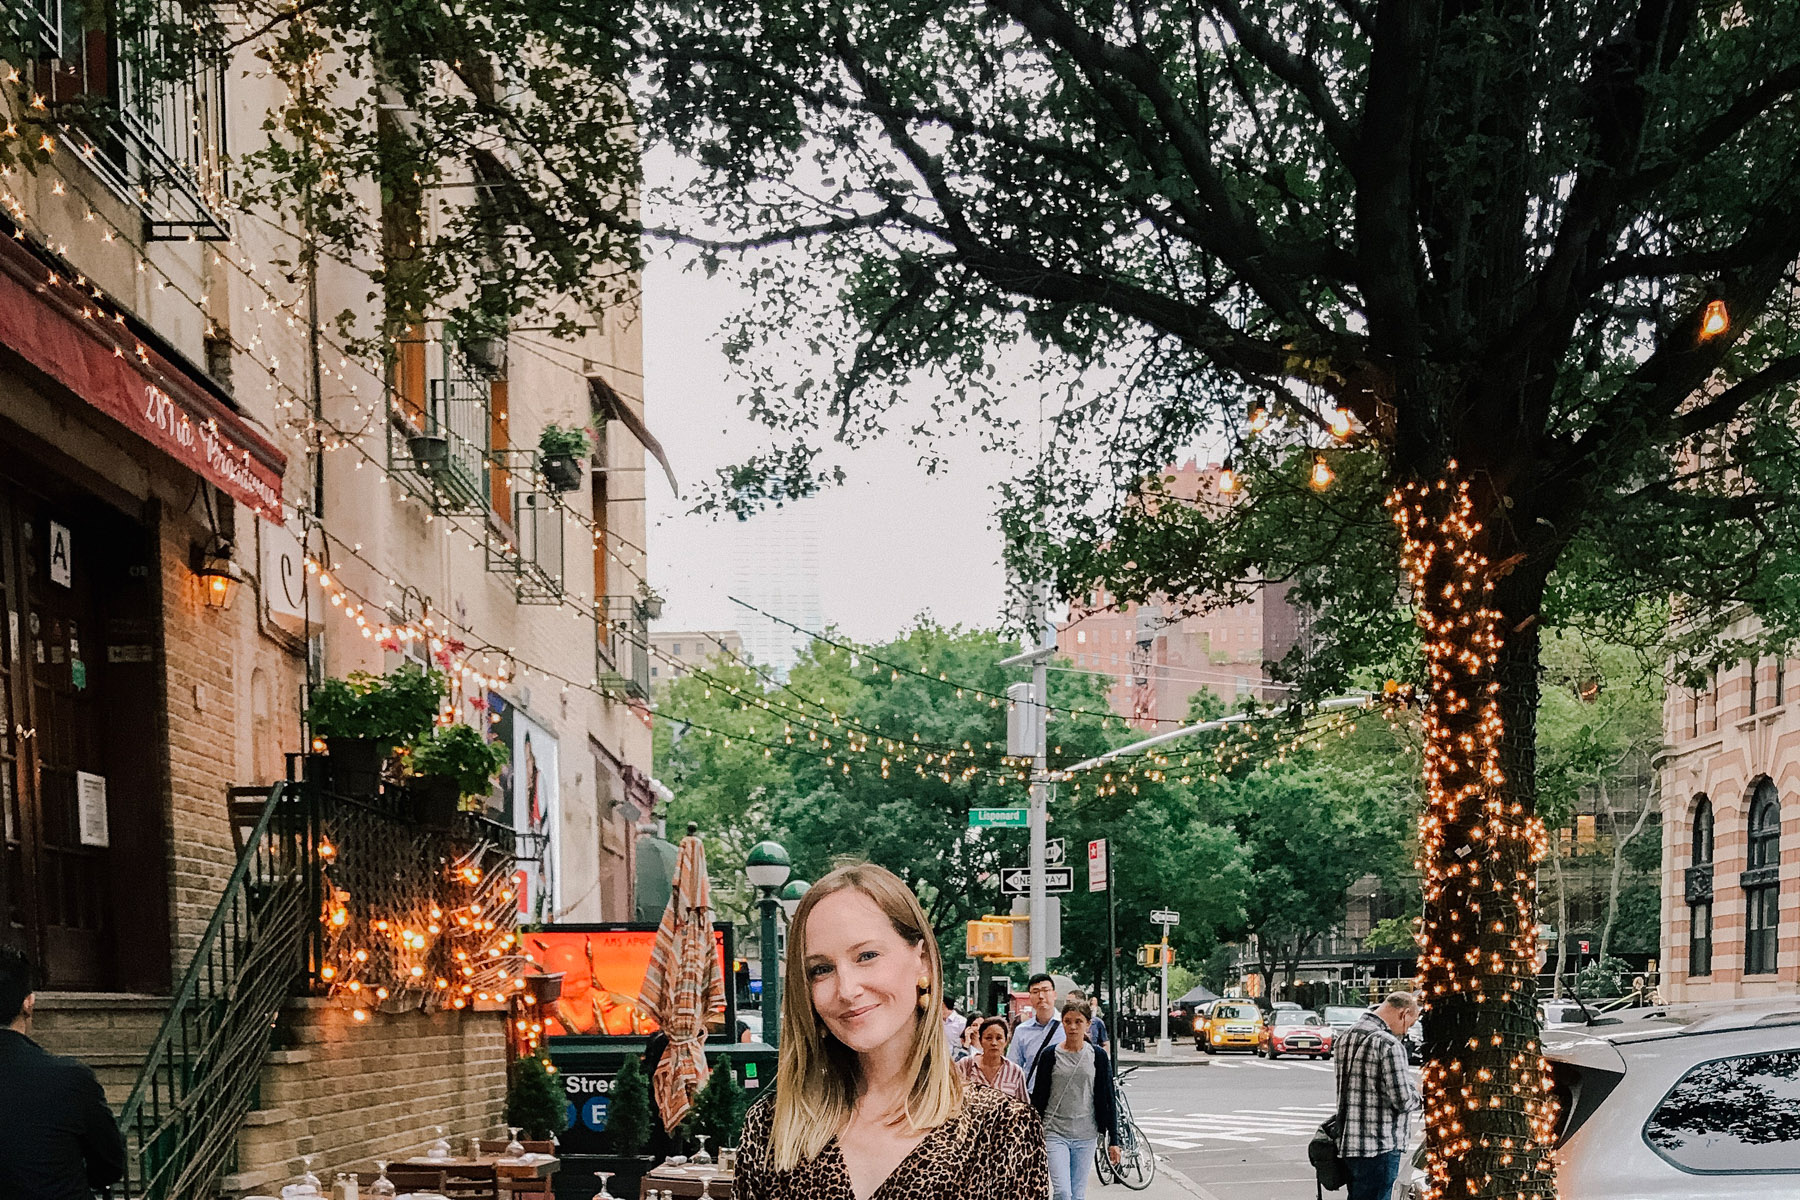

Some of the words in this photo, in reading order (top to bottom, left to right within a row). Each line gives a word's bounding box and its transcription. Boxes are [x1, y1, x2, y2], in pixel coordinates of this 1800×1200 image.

[145, 385, 175, 437] 281
[53, 531, 68, 571] A
[566, 1076, 616, 1093] Stree
[592, 1104, 607, 1124] E
